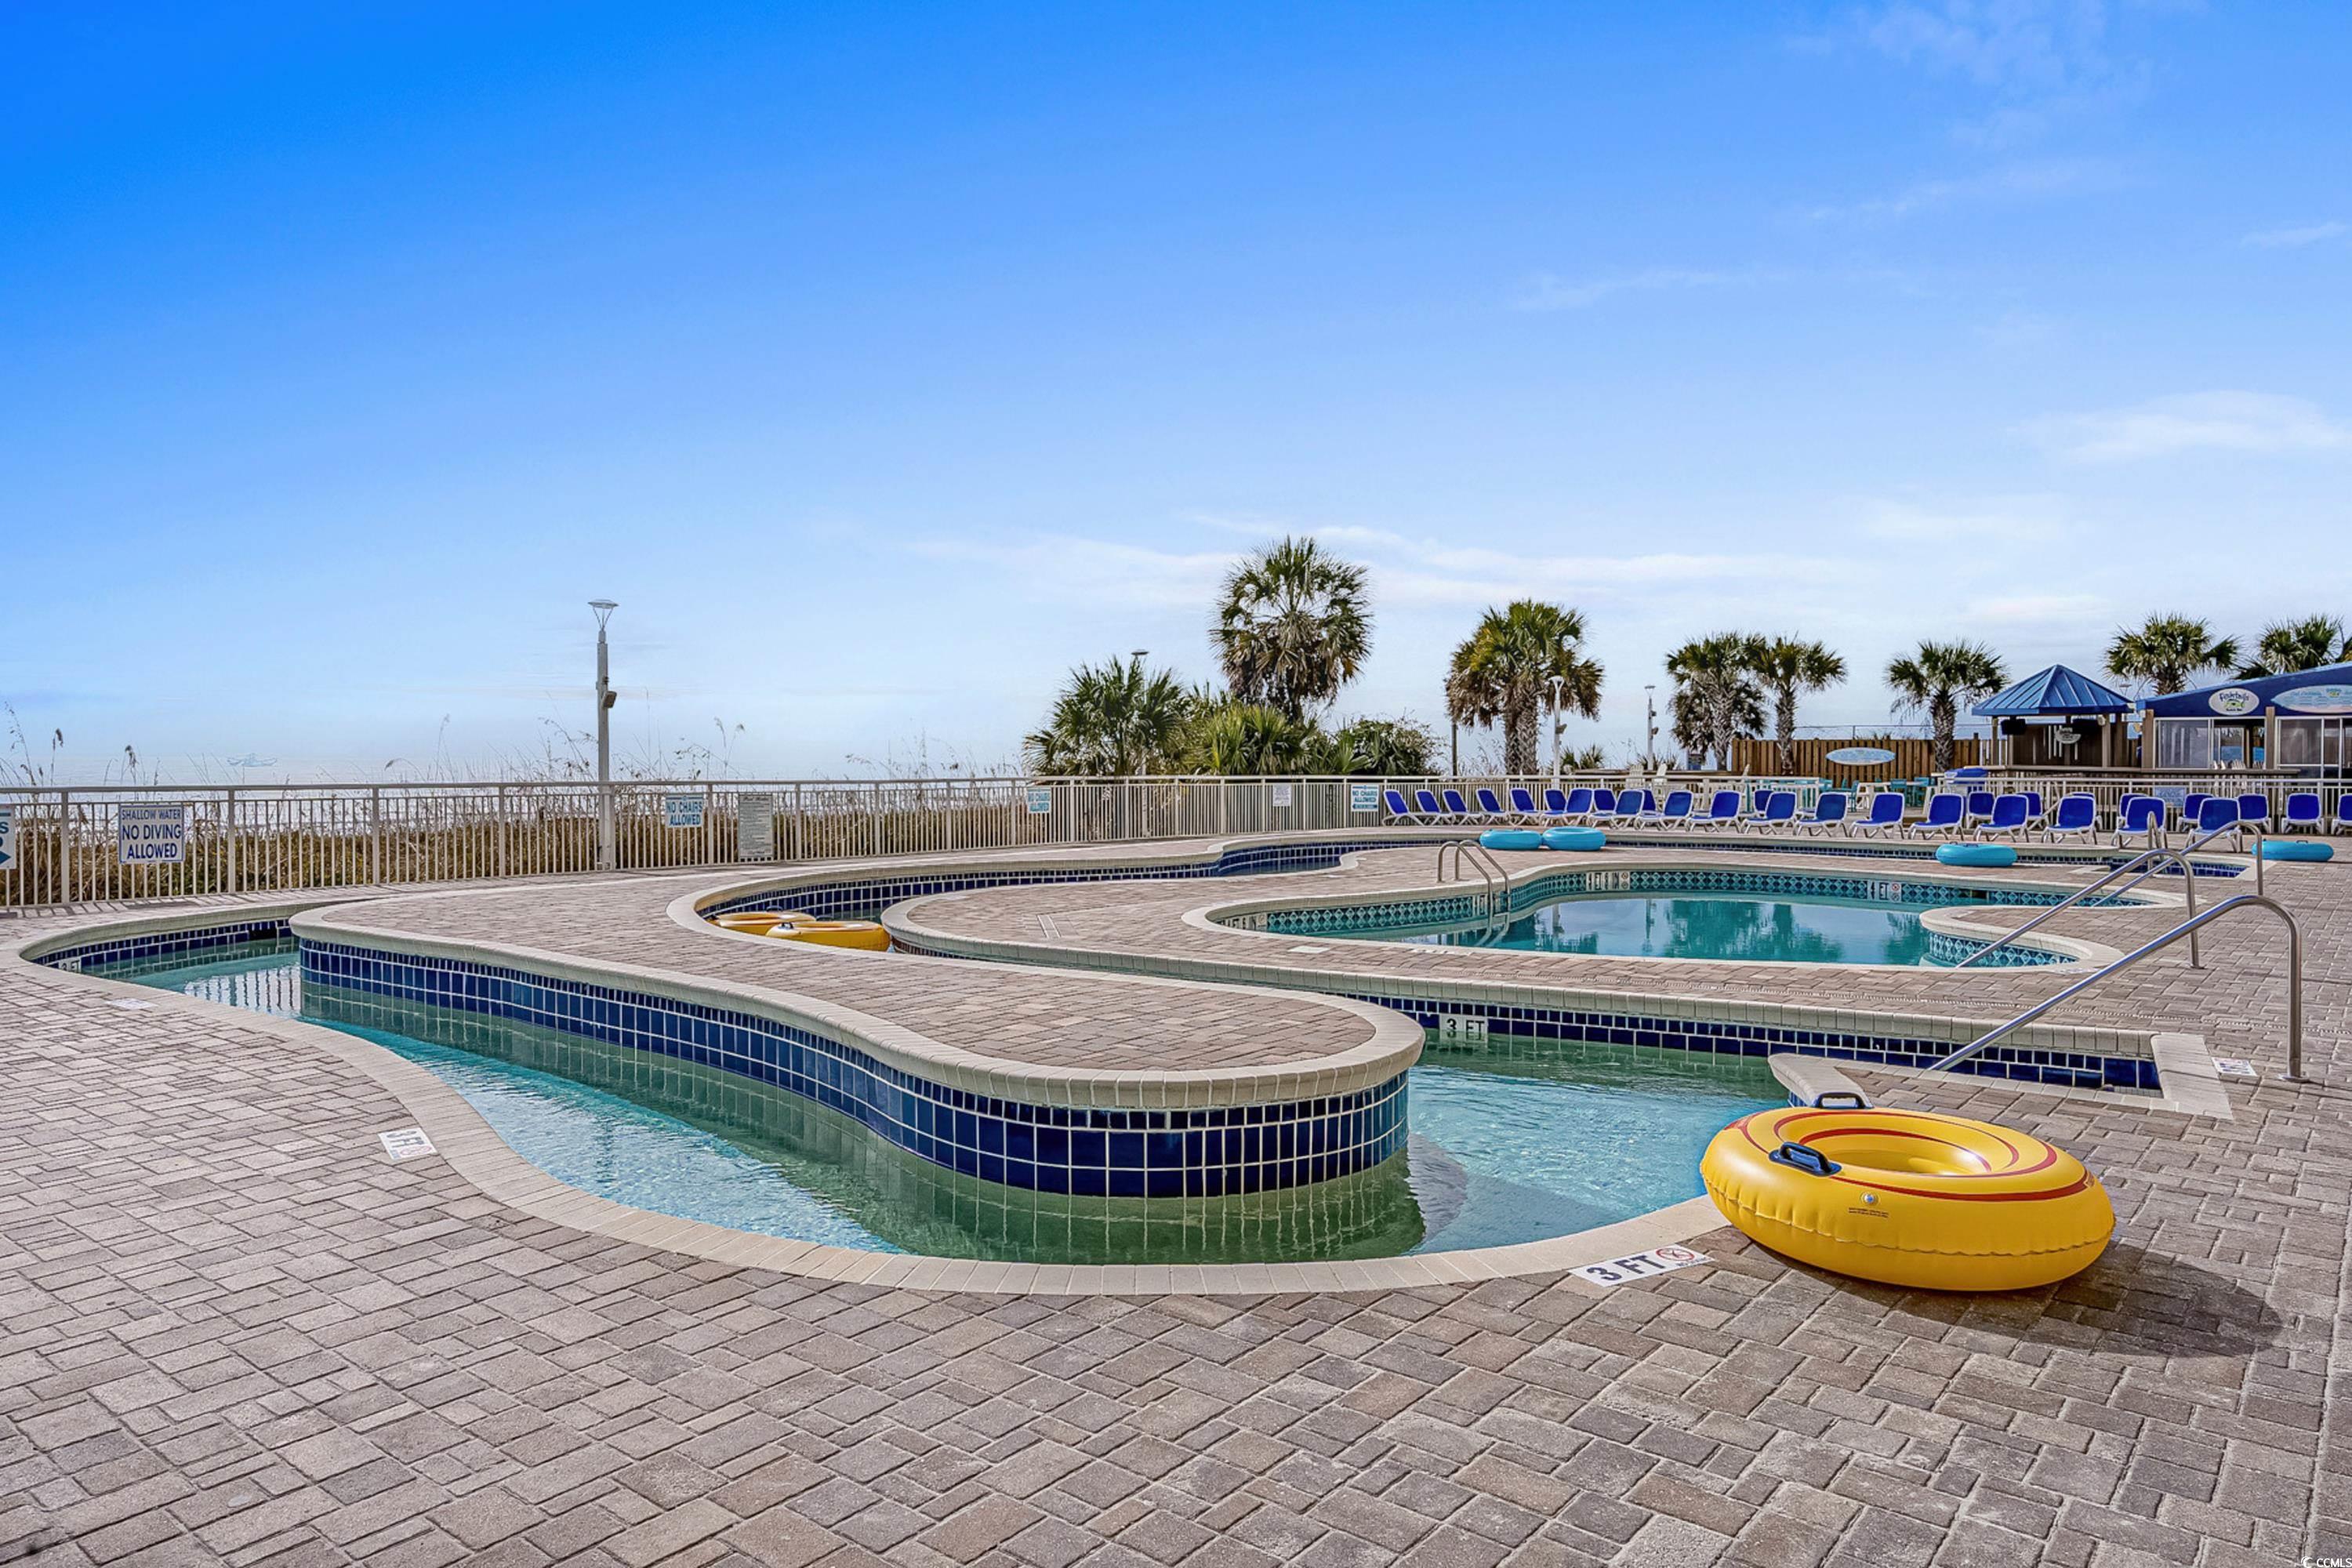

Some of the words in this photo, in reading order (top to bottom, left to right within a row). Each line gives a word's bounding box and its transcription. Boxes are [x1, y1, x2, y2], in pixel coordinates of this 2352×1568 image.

[122, 809, 156, 820] SHALLOW
[159, 809, 180, 820] WATER
[666, 801, 677, 813] NO
[679, 801, 702, 813] CHAIRS
[670, 814, 701, 826] ALLOWED
[122, 825, 140, 840] NO
[143, 824, 181, 840] DIVING
[127, 843, 177, 859] ALLOWED
[1446, 1018, 1457, 1039] 3
[1465, 1020, 1485, 1040] FT
[1586, 1267, 1622, 1281] 3
[1613, 1255, 1665, 1275] FT
